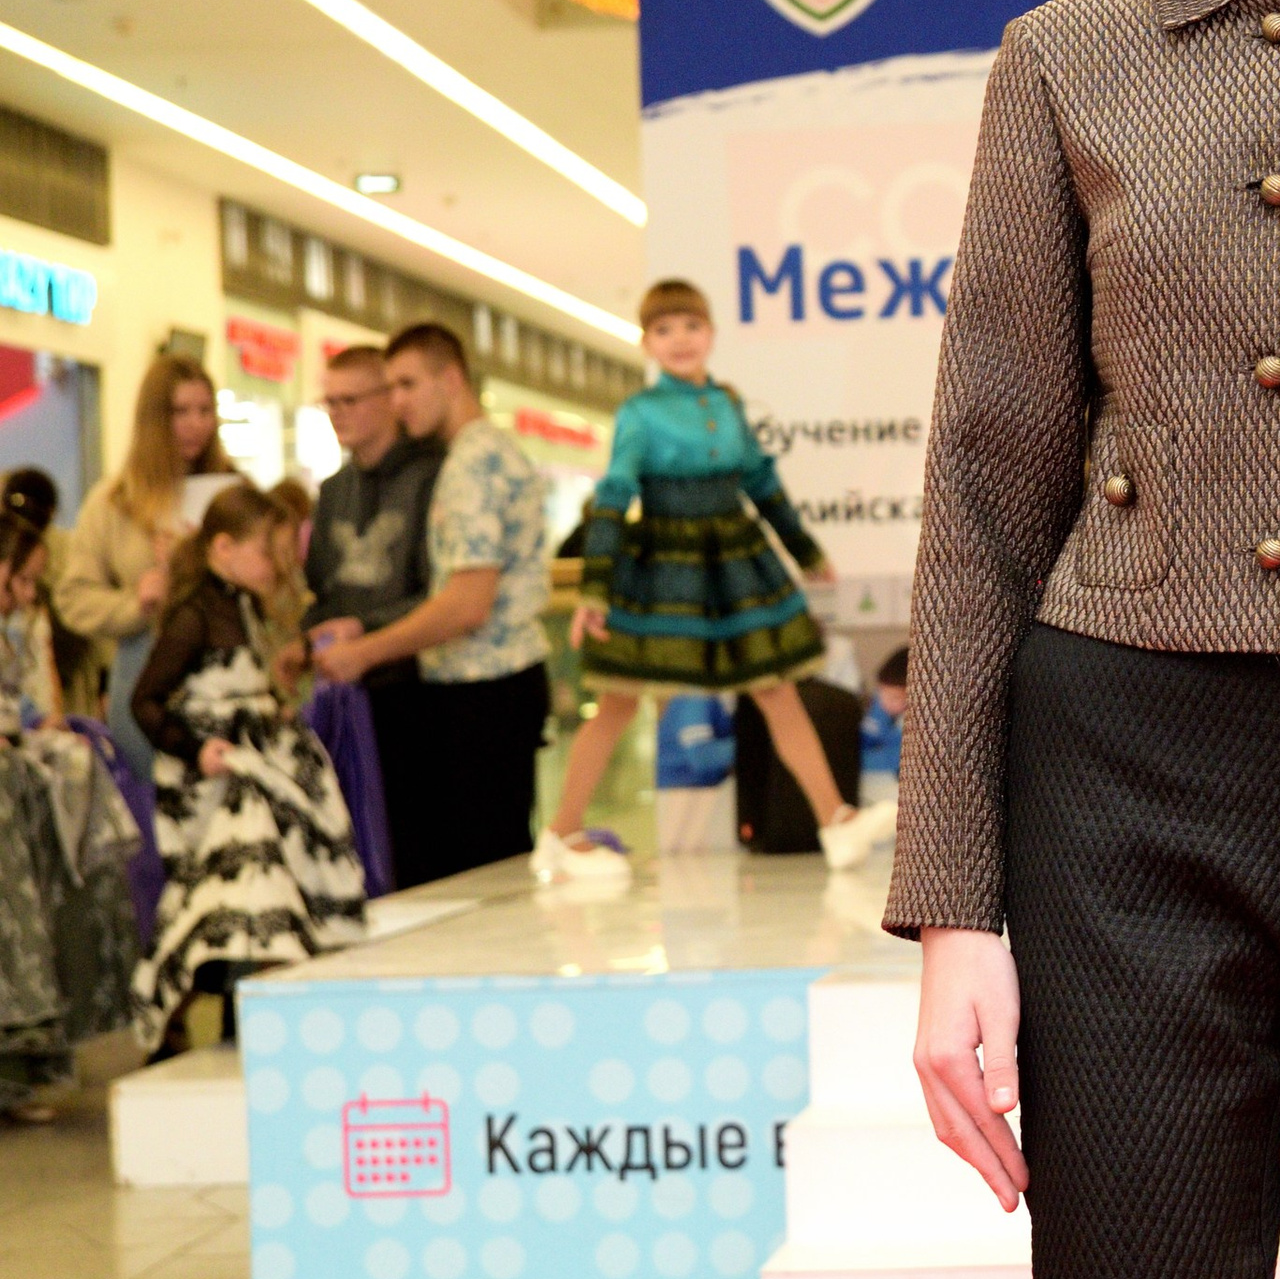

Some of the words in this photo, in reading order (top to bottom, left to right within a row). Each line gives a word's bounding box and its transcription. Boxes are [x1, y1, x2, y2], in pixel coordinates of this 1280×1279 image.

[736, 242, 955, 325] Меж
[755, 413, 923, 454] бучение
[797, 490, 922, 523] лийска
[484, 1113, 748, 1182] Каждые
